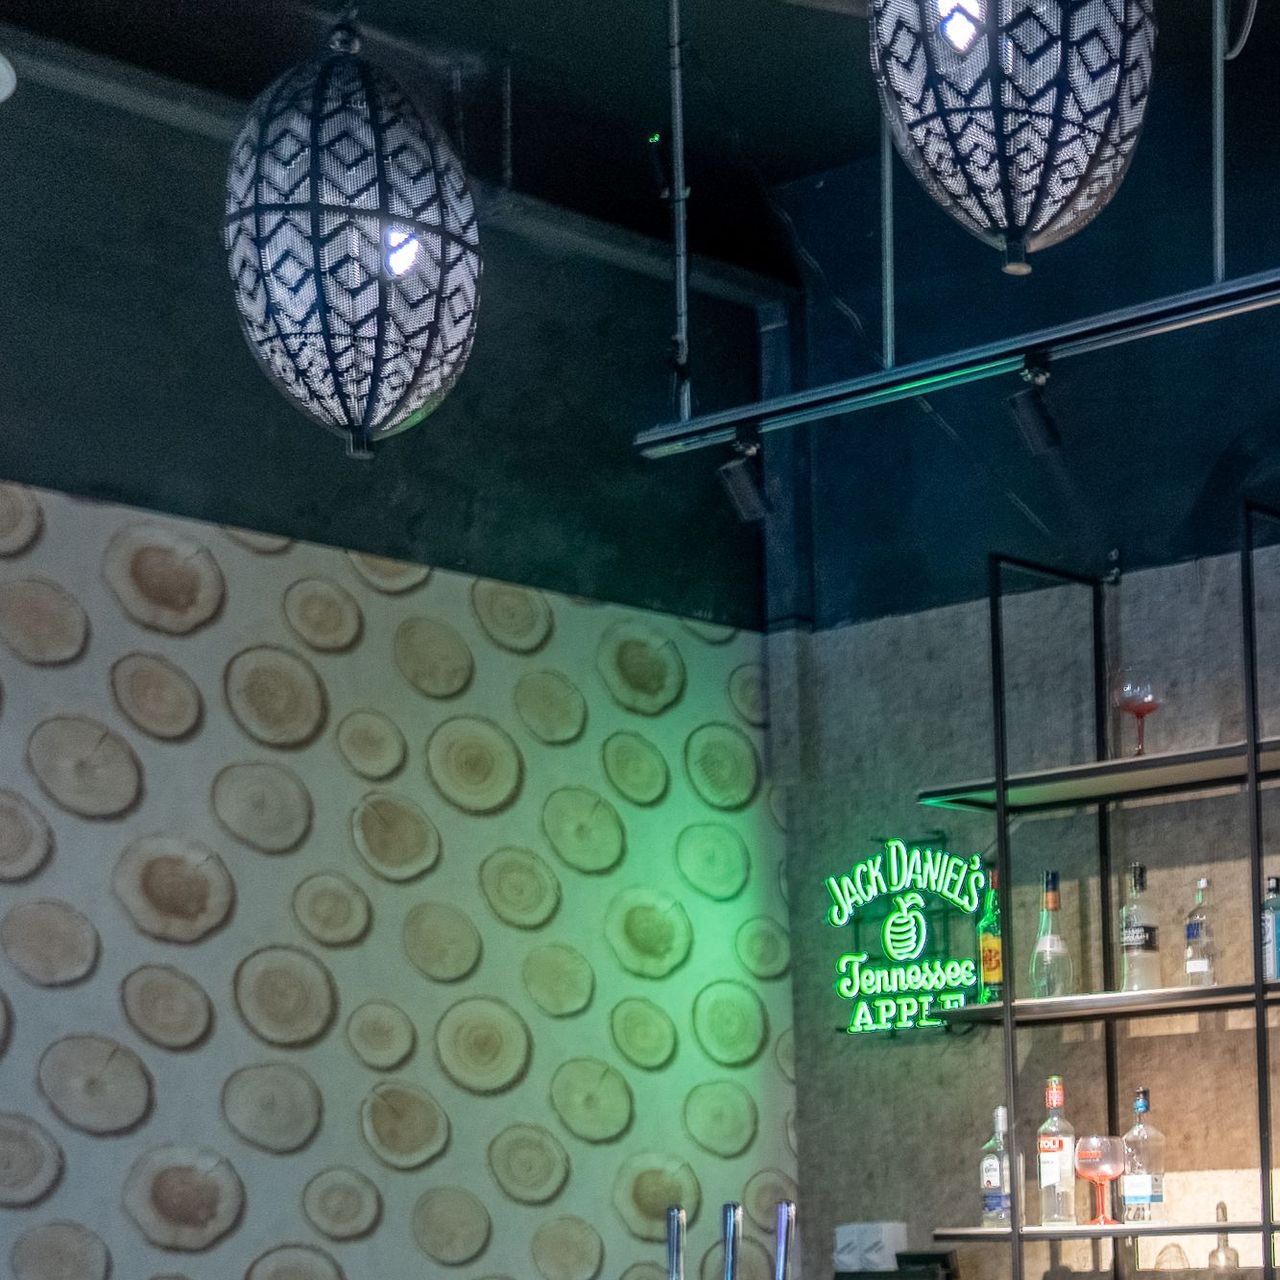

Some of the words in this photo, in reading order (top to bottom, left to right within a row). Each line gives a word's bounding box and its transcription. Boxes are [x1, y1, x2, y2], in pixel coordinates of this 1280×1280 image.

[825, 855, 888, 927] JACK
[885, 838, 985, 913] DANIEL'S
[836, 951, 977, 999] Tennessee
